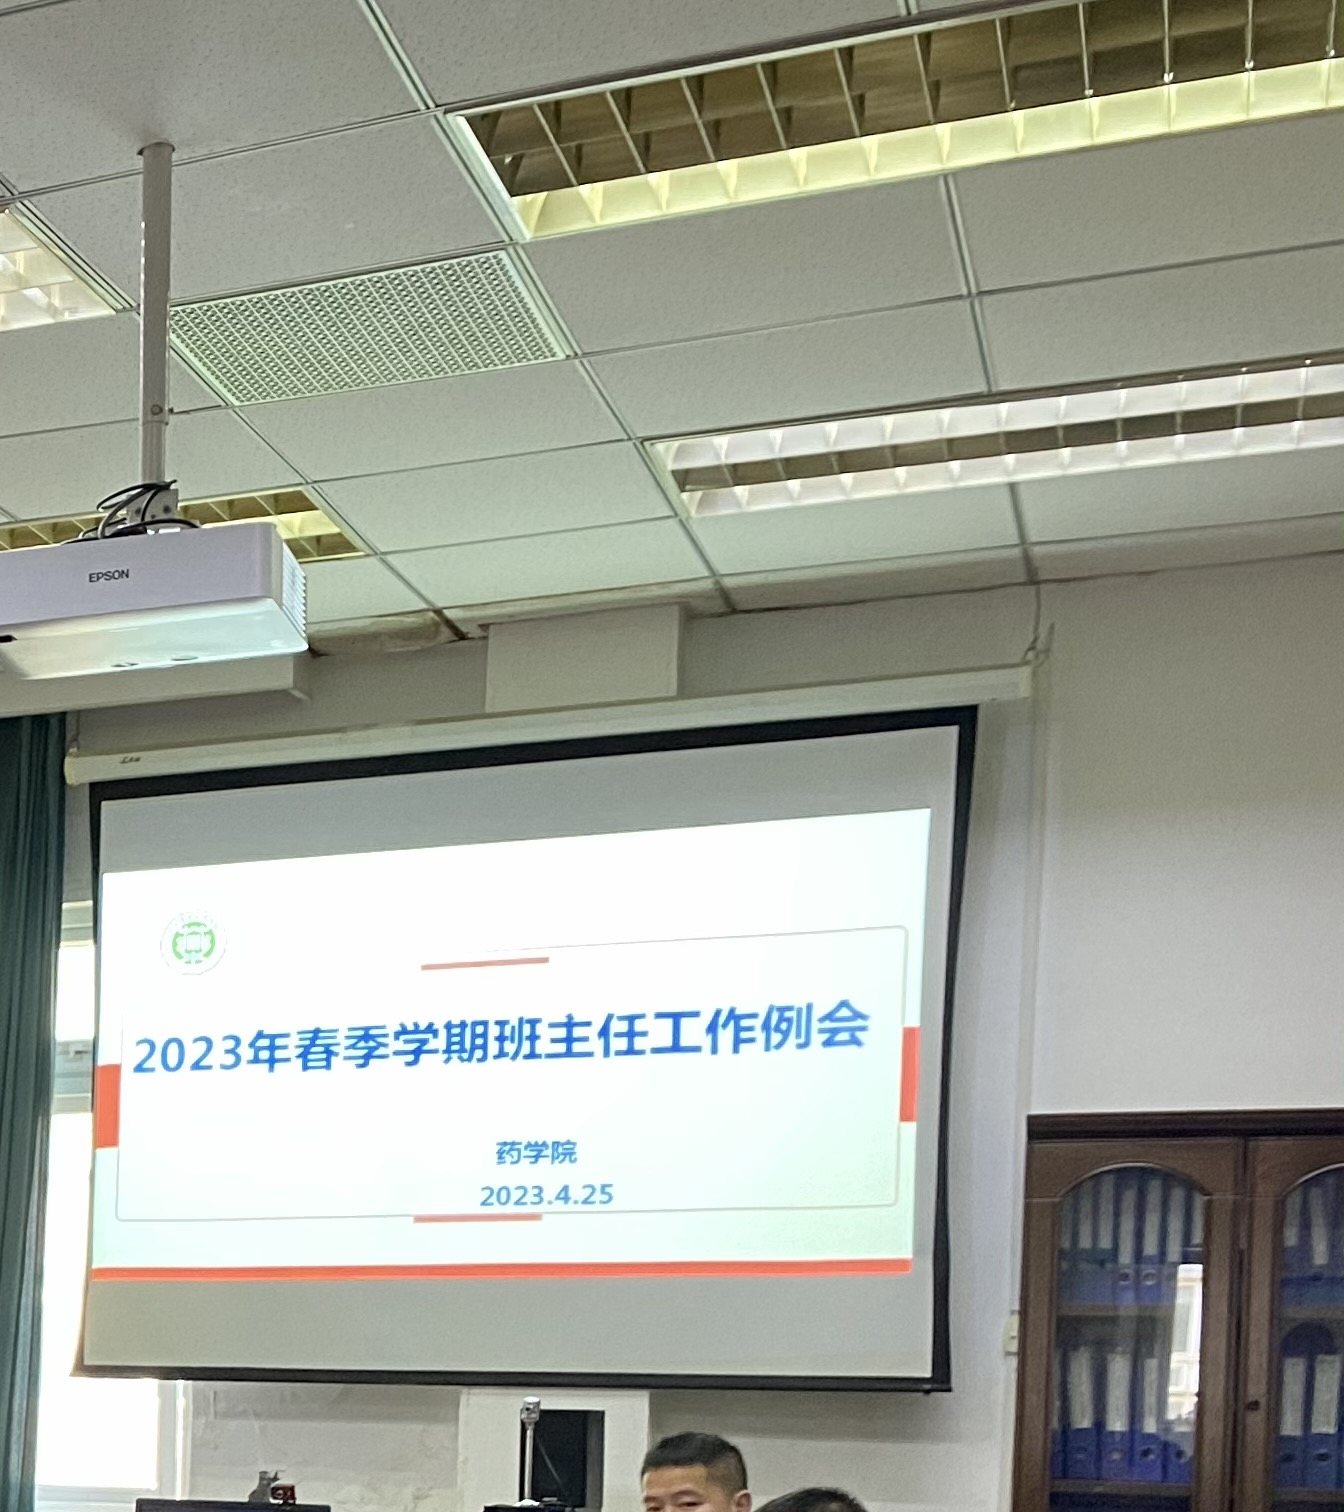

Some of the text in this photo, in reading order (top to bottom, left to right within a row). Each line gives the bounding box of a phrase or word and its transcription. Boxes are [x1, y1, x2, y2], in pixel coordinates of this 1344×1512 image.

[89, 569, 130, 583] EPSON
[133, 999, 870, 1076] 2023年春季学期班主任工作例会
[496, 1140, 578, 1165] 药学院
[480, 1183, 614, 1207] 2023.4.25
